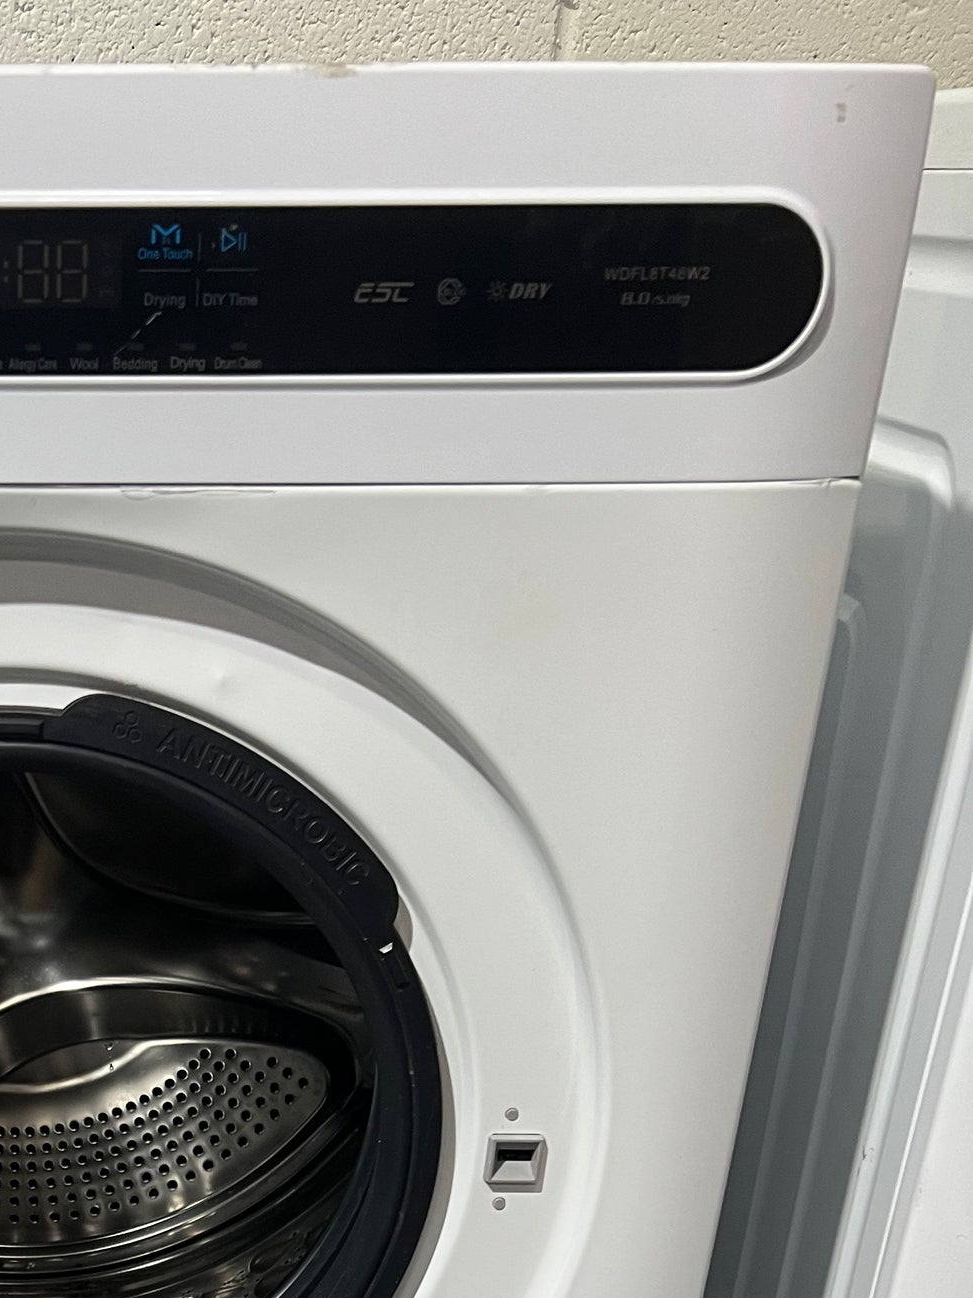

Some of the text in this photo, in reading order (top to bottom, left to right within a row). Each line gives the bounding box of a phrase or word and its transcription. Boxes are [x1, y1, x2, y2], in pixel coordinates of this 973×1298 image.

[137, 246, 194, 260] One Touch
[509, 281, 554, 300] DRY
[144, 292, 186, 309] Drying
[203, 293, 259, 306] DIY Time
[69, 357, 99, 370] Wool
[113, 357, 158, 371] Bedding
[170, 356, 206, 371] Drying
